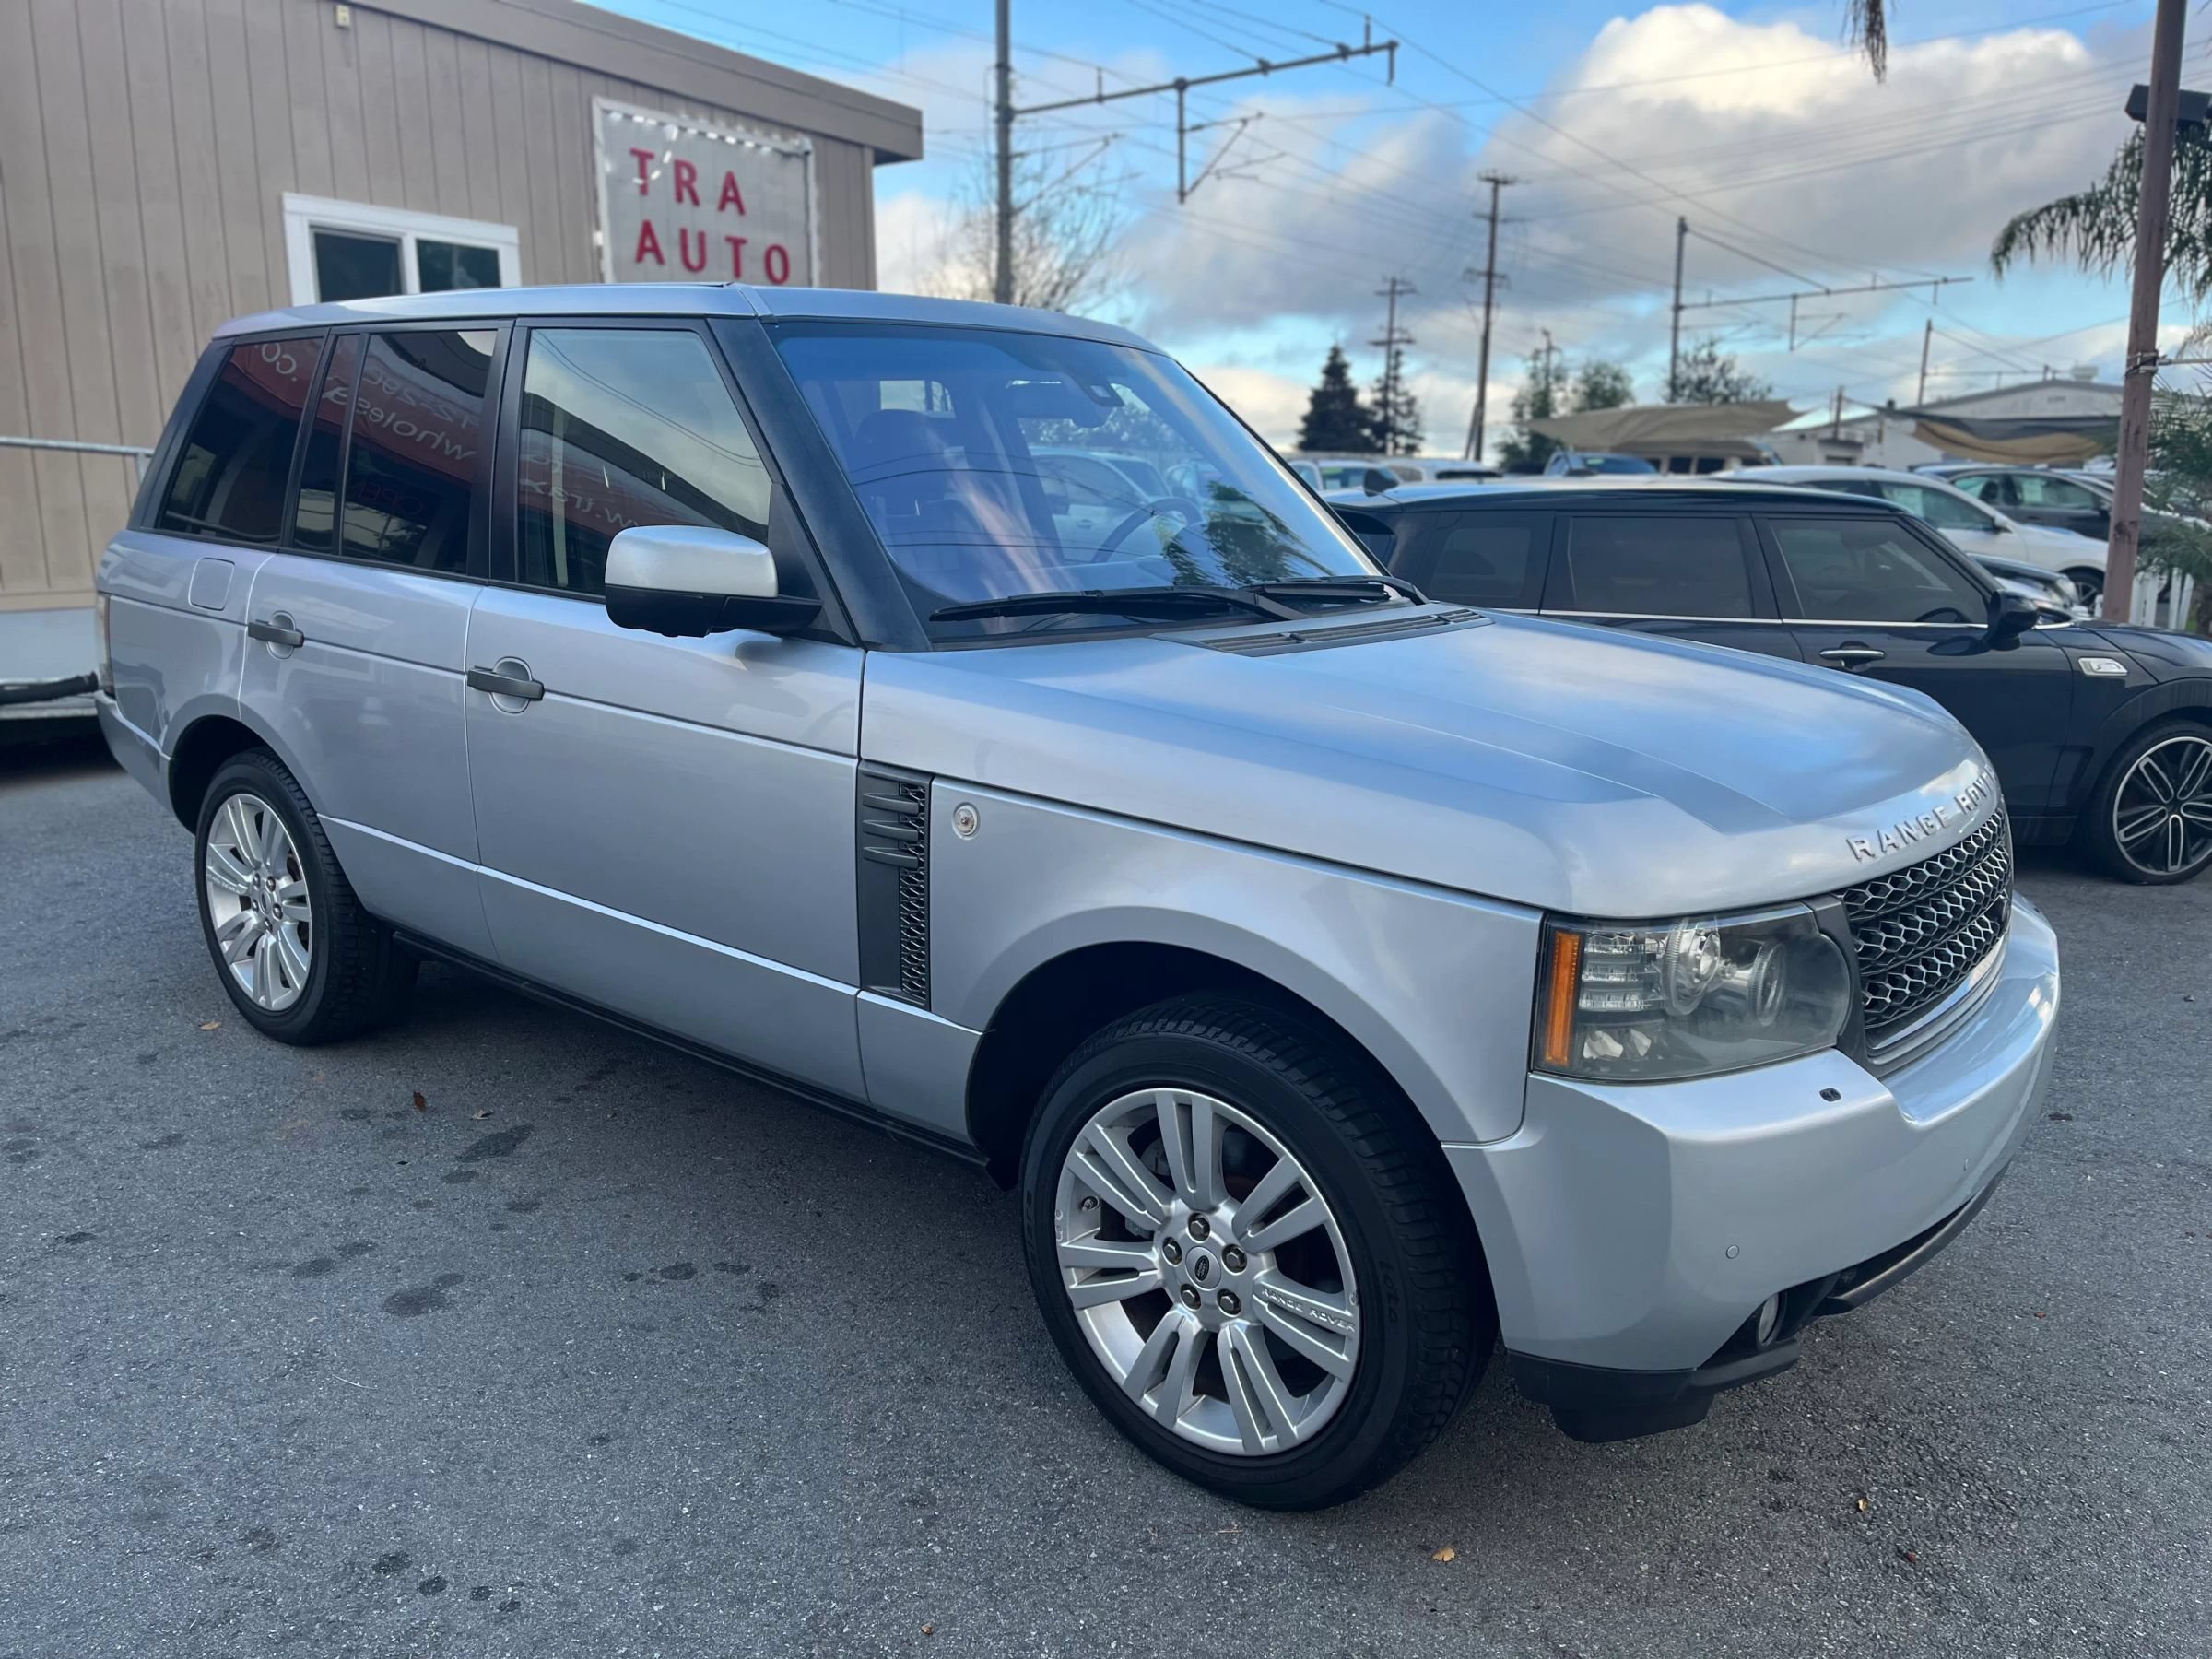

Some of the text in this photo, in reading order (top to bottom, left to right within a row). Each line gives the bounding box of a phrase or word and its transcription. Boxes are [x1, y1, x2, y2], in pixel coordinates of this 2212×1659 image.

[629, 147, 746, 217] TRA
[635, 219, 791, 285] AUTO
[1845, 805, 1953, 864] RANGE
[1309, 1308, 1357, 1334] ROVER
